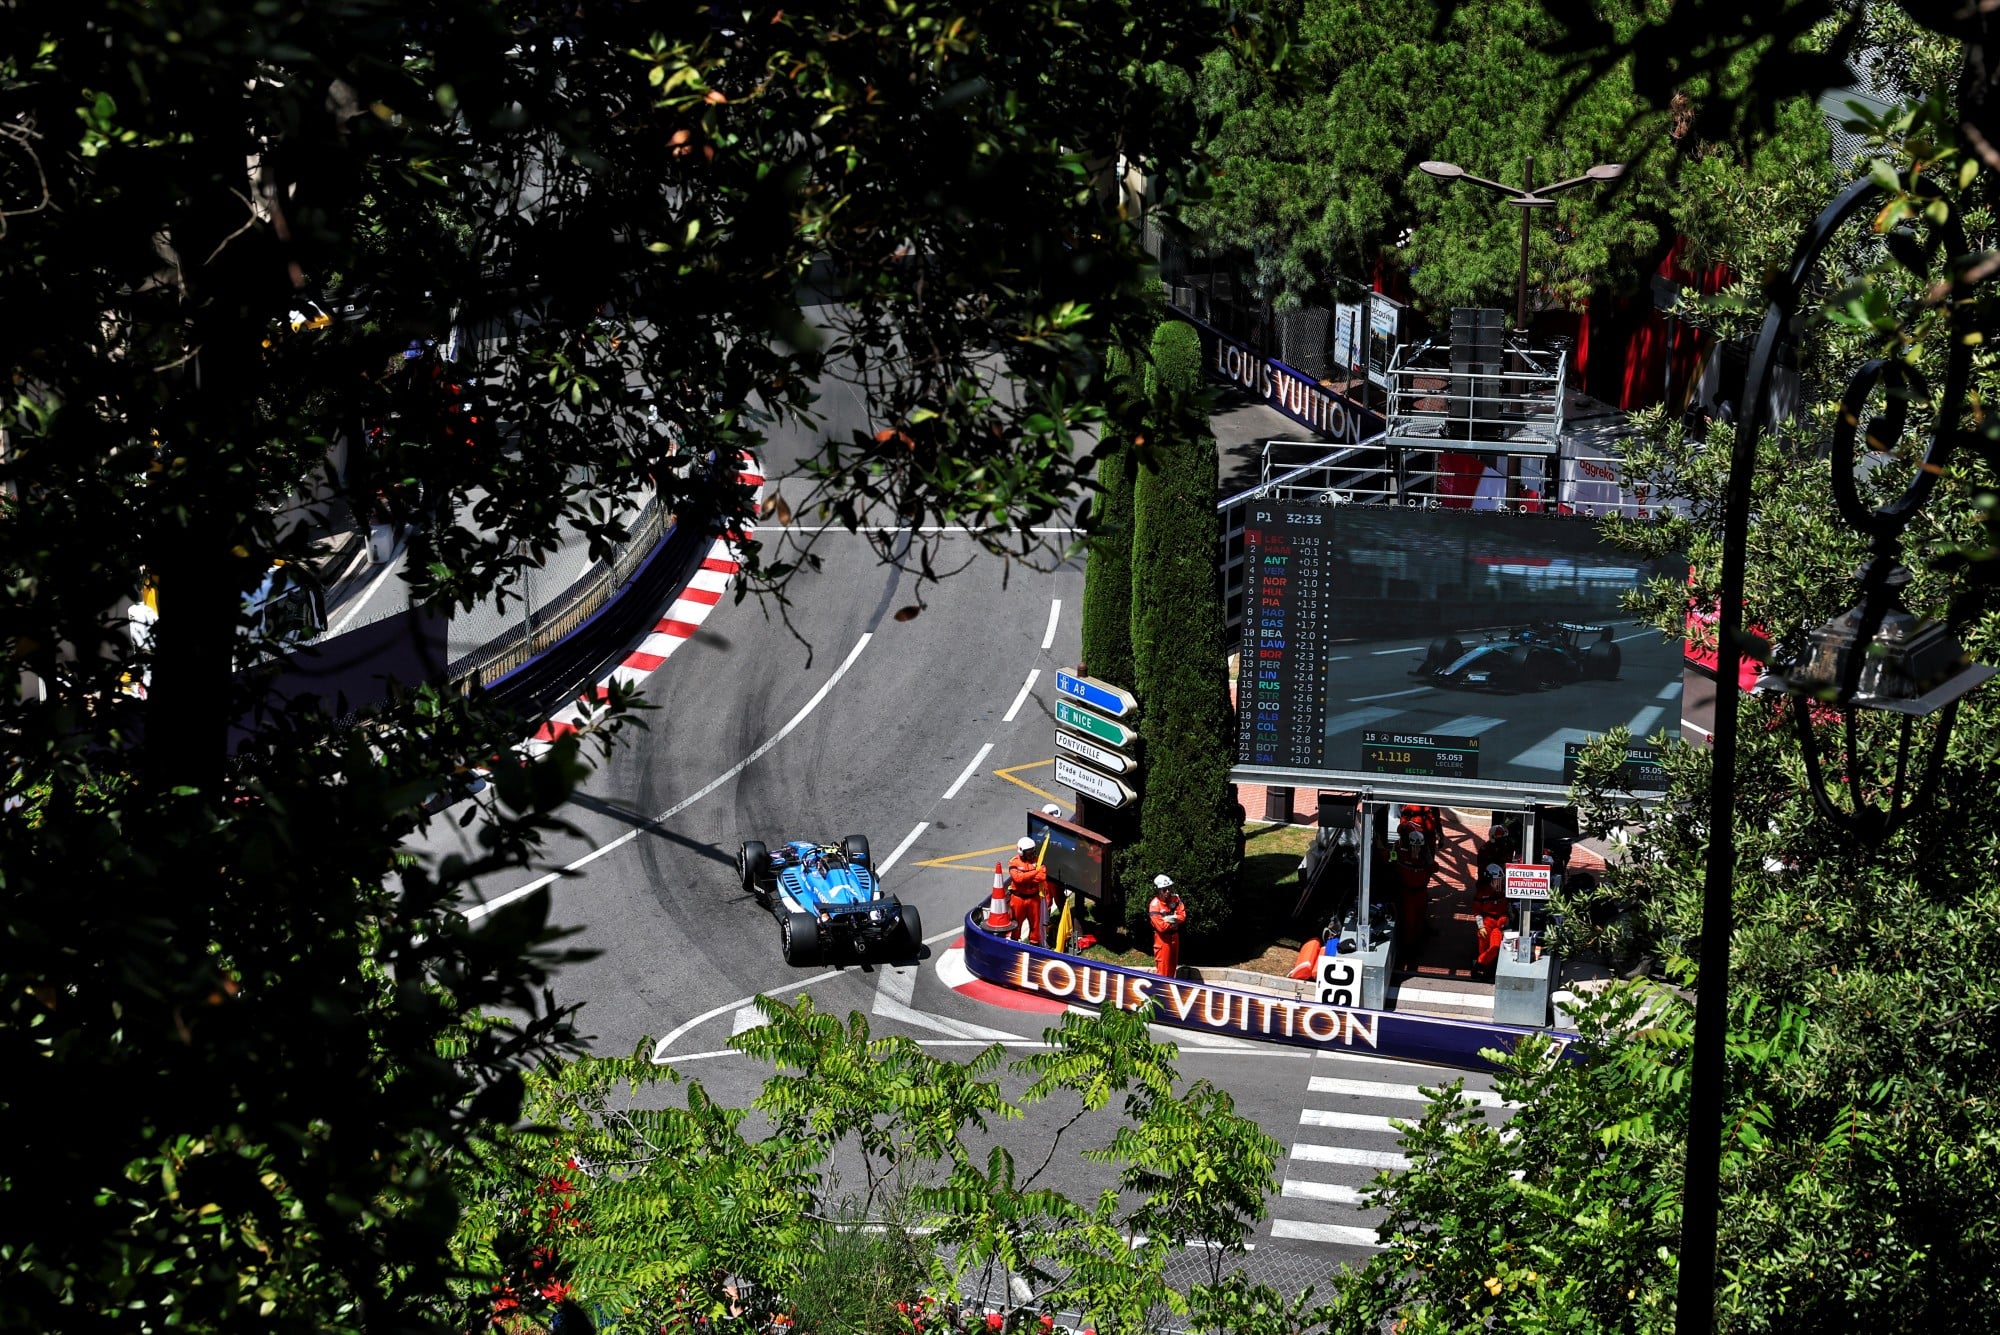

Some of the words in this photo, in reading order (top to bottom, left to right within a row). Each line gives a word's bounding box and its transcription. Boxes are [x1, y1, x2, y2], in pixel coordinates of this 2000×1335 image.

[1218, 338, 1272, 399] LOUIS
[1277, 370, 1361, 445] VUITTON
[1580, 460, 1615, 481] aggreko
[1256, 512, 1272, 522] P1
[1286, 513, 1322, 525] 32:33
[1250, 535, 1256, 543] 1
[1264, 536, 1285, 544] LEC
[1292, 537, 1320, 546] 1:14.9
[1250, 545, 1256, 553] 2
[1264, 546, 1291, 555] HAM
[1300, 547, 1318, 556] +0.1
[1264, 556, 1288, 565] ANT
[1299, 558, 1319, 567] +0.5
[1264, 567, 1285, 575] VER
[1298, 569, 1318, 577] +0.9
[1263, 577, 1287, 586] NOR
[1298, 580, 1318, 588] +1.0
[1262, 588, 1284, 596] HUL
[1298, 590, 1317, 598] +1.3
[1248, 597, 1254, 605] 7
[1262, 598, 1280, 607] PIA
[1297, 600, 1317, 609] +1.5
[1247, 608, 1253, 616] 8
[1297, 610, 1317, 619] +1.6
[1247, 618, 1253, 626] 9
[1261, 619, 1284, 628] GAS
[1296, 621, 1316, 629] +1.7
[1244, 628, 1255, 636] 10
[1261, 629, 1282, 638] BEA
[1296, 631, 1316, 640] +2.0
[1243, 639, 1254, 647] 11
[1260, 640, 1286, 648] LAW
[1295, 642, 1315, 650] +2.1
[1243, 649, 1254, 657] 12
[1260, 650, 1282, 659] BOR
[1295, 652, 1314, 661] +2.3
[1242, 660, 1254, 668] 13
[1259, 660, 1281, 669] PER
[1294, 662, 1314, 671] +2.3
[1242, 670, 1253, 678] 14
[1259, 671, 1277, 679] LIN
[1294, 673, 1313, 681] +2.4
[1073, 683, 1086, 696] A8
[1241, 680, 1253, 688] 15
[1258, 681, 1280, 690] RUS
[1293, 683, 1313, 692] +2.5
[1241, 691, 1252, 699] 16
[1258, 691, 1280, 700] STR
[1293, 693, 1313, 702] +2.6
[1241, 701, 1252, 709] 17
[1257, 702, 1280, 711] OCO
[1292, 704, 1312, 713] +2.6
[1073, 711, 1092, 729] NICE
[1240, 711, 1252, 720] 18
[1257, 713, 1279, 721] ALB
[1292, 714, 1312, 723] +2.7
[1240, 722, 1251, 730] 19
[1257, 723, 1277, 731] COL
[1291, 725, 1311, 733] +2.7
[1239, 732, 1251, 740] 20
[1256, 733, 1278, 742] ALO
[1291, 735, 1311, 744] +2.8
[1365, 733, 1376, 741] 15
[1393, 735, 1435, 745] RUSSELL
[1058, 735, 1100, 760] FONTVIEILLE
[1239, 742, 1250, 751] 21
[1256, 743, 1279, 752] BOT
[1290, 746, 1311, 754] +3.0
[1570, 746, 1576, 754] 3
[1625, 750, 1652, 759] NELLI
[1238, 753, 1250, 761] 22
[1256, 753, 1273, 762] SAI
[1290, 756, 1310, 764] +3.0
[1370, 751, 1411, 763] +1.118
[1436, 753, 1463, 761] 55.053
[1435, 761, 1464, 769] LECLERC
[1640, 766, 1663, 775] 55.05
[1058, 762, 1076, 776] Stade
[1079, 770, 1096, 784] Louis
[1097, 778, 1103, 787] II
[1508, 870, 1535, 878] SECTEUR
[1509, 880, 1547, 888] INTERVENTION
[1321, 963, 1355, 1008] SC
[1021, 952, 1152, 1013] LOUIS
[1169, 984, 1379, 1049] VUITTON
